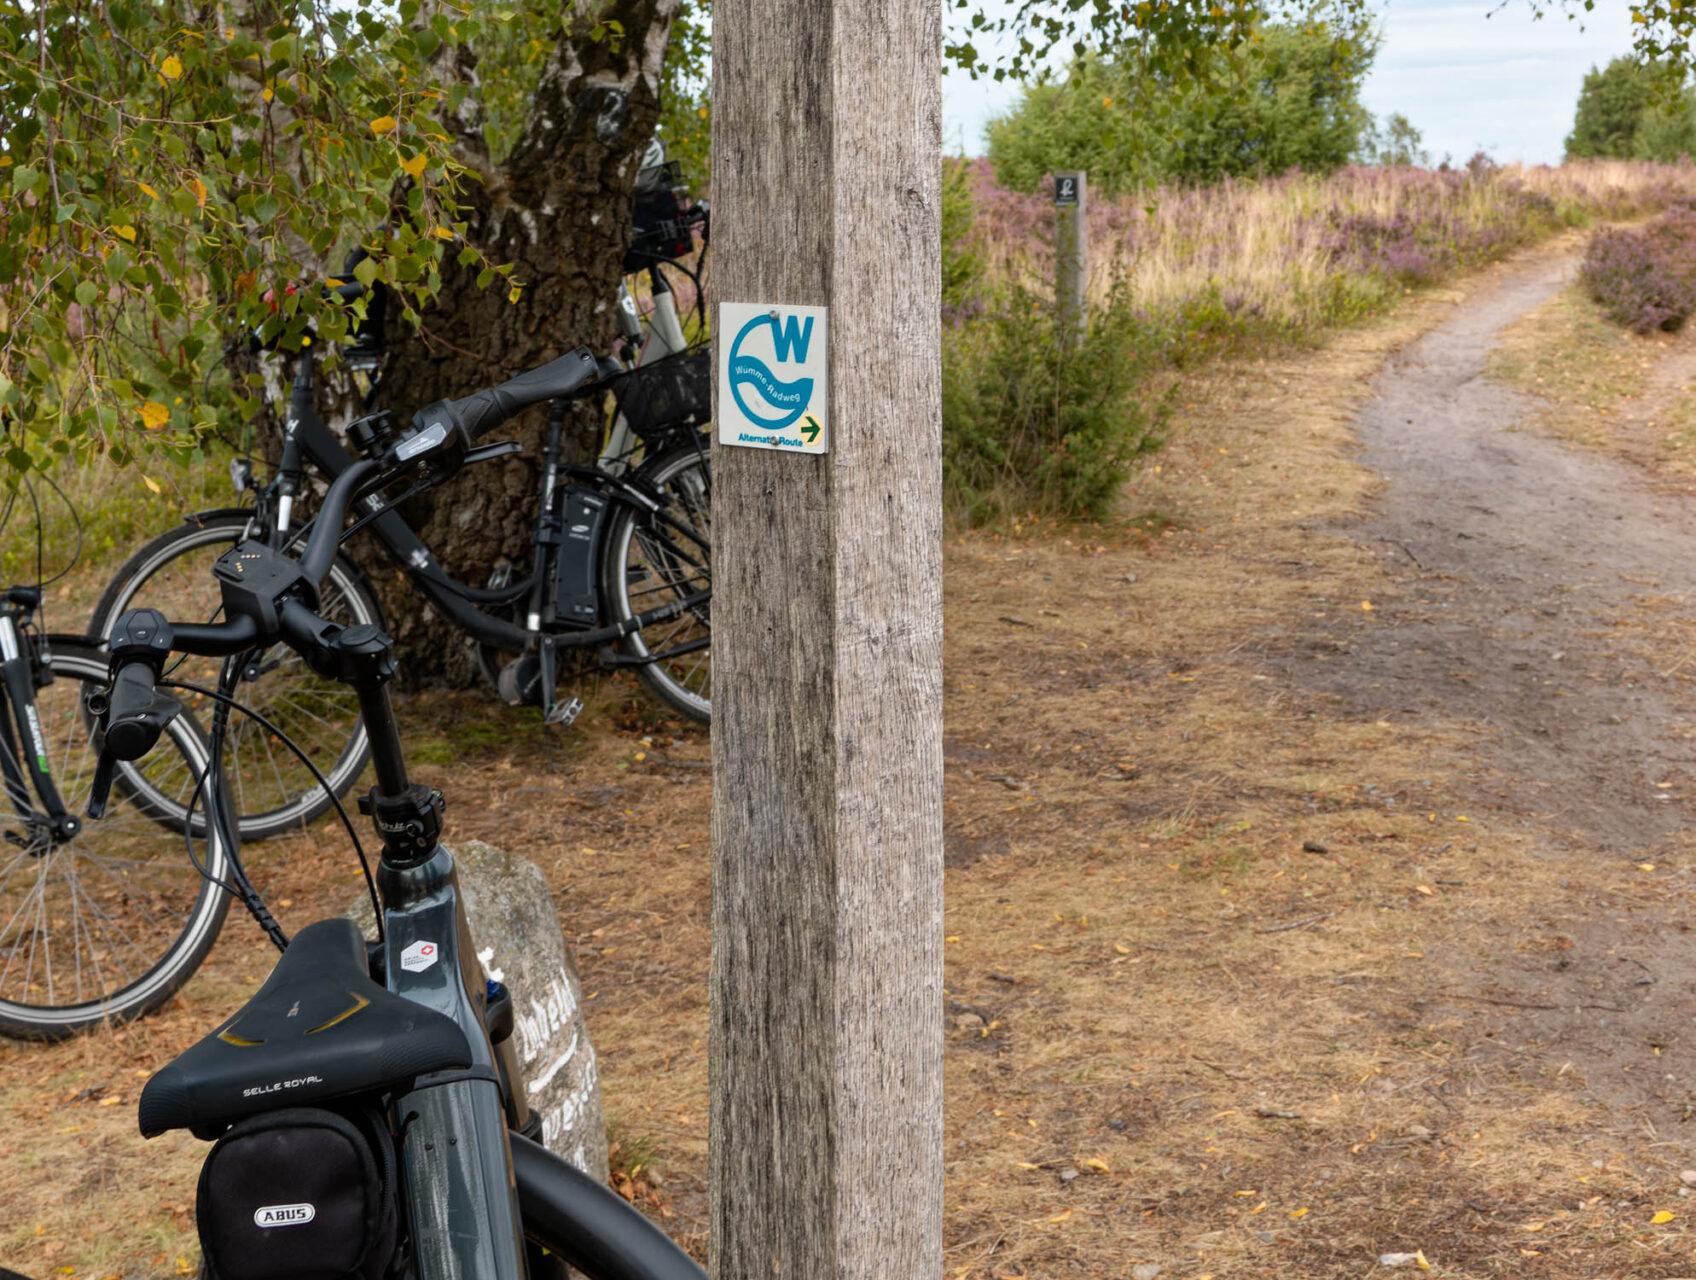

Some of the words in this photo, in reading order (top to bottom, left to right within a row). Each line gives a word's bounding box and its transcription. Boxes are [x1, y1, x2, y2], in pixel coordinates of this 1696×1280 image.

[738, 432, 803, 448] AlternatRoute
[243, 1082, 283, 1097] SELLE
[283, 1076, 323, 1088] ROYAL
[264, 1208, 307, 1223] ABUS
